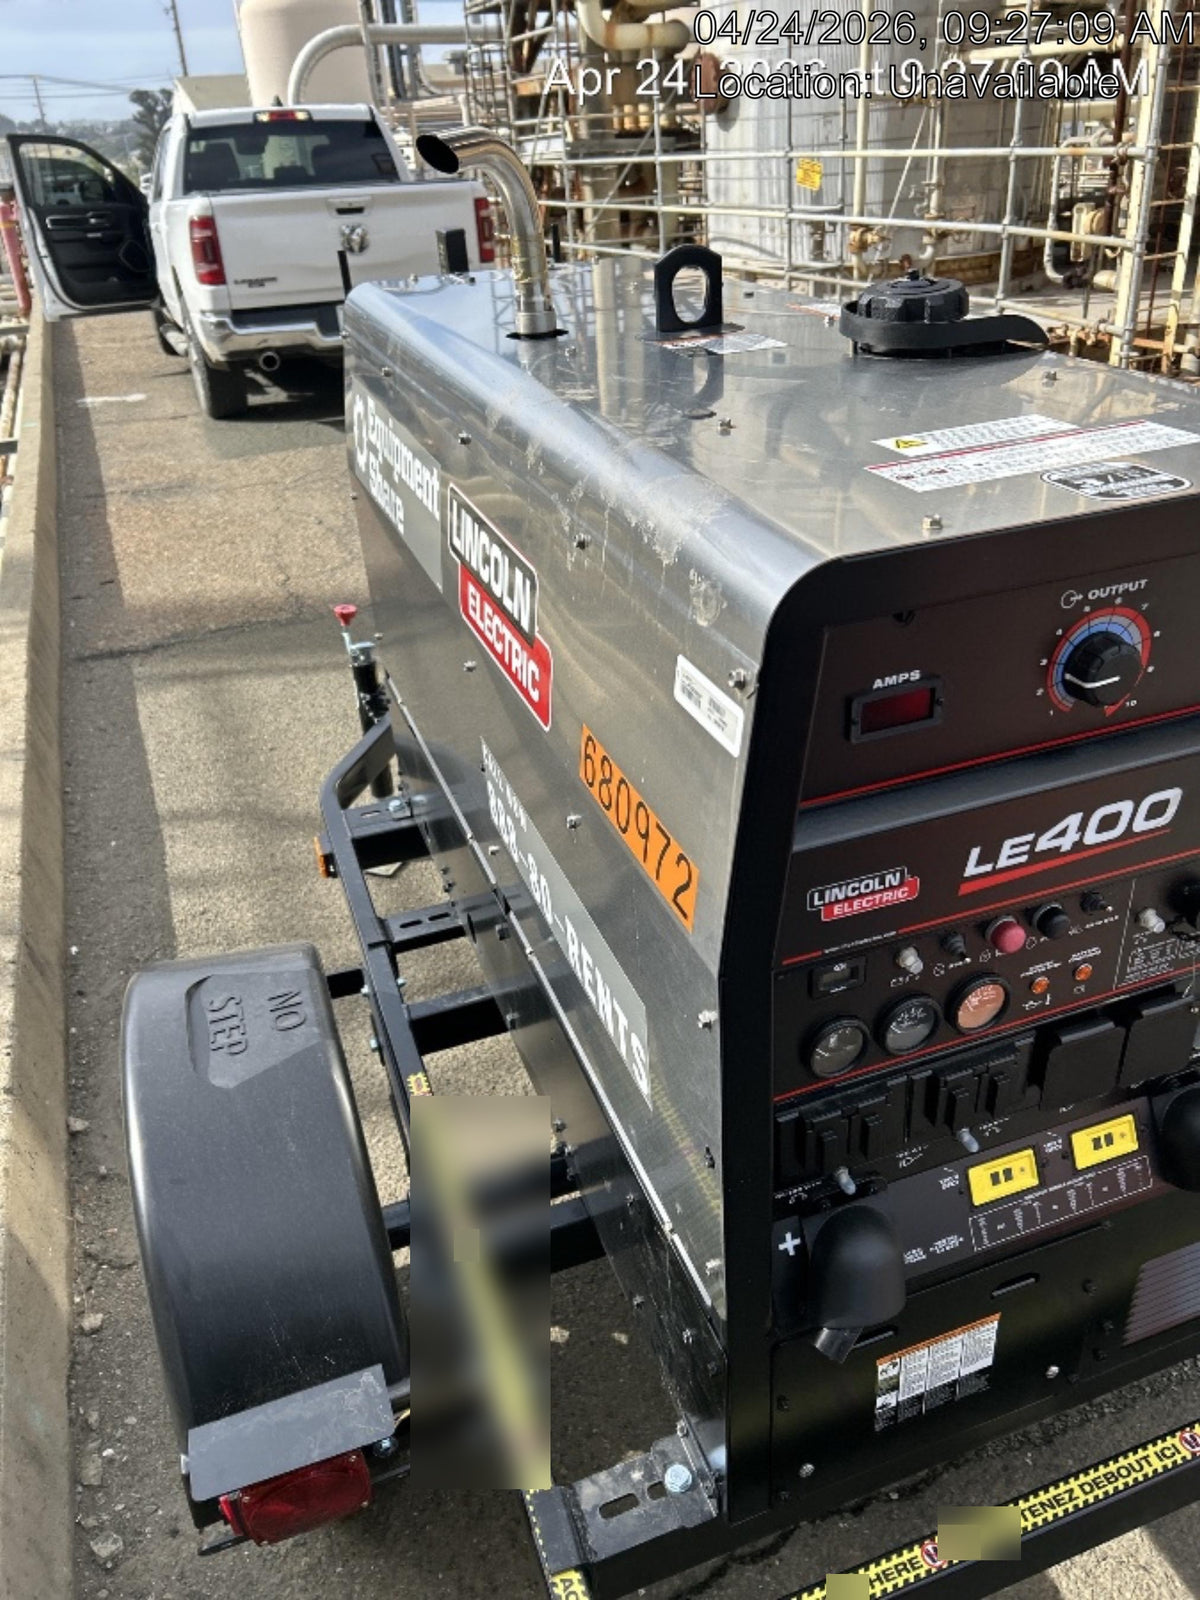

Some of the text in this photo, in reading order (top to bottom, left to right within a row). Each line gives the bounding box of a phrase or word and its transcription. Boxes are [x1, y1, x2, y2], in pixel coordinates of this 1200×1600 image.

[367, 395, 440, 522] Equipment
[452, 499, 531, 634] LINCOLN
[1087, 578, 1149, 601] OUTPUT
[467, 580, 540, 703] ELECTRIC
[872, 669, 921, 690] AMPS
[584, 735, 693, 921] 680972
[963, 787, 1184, 878] LE400
[813, 871, 901, 906] LINCOLN
[833, 886, 909, 916] ELECTRIC
[486, 779, 650, 1102] 888-80-RENTS
[208, 995, 249, 1057] STEP
[267, 989, 307, 1032] NO
[1021, 1443, 1181, 1523] TENEZ DEBOUT ICI
[869, 1555, 923, 1588] HERE
